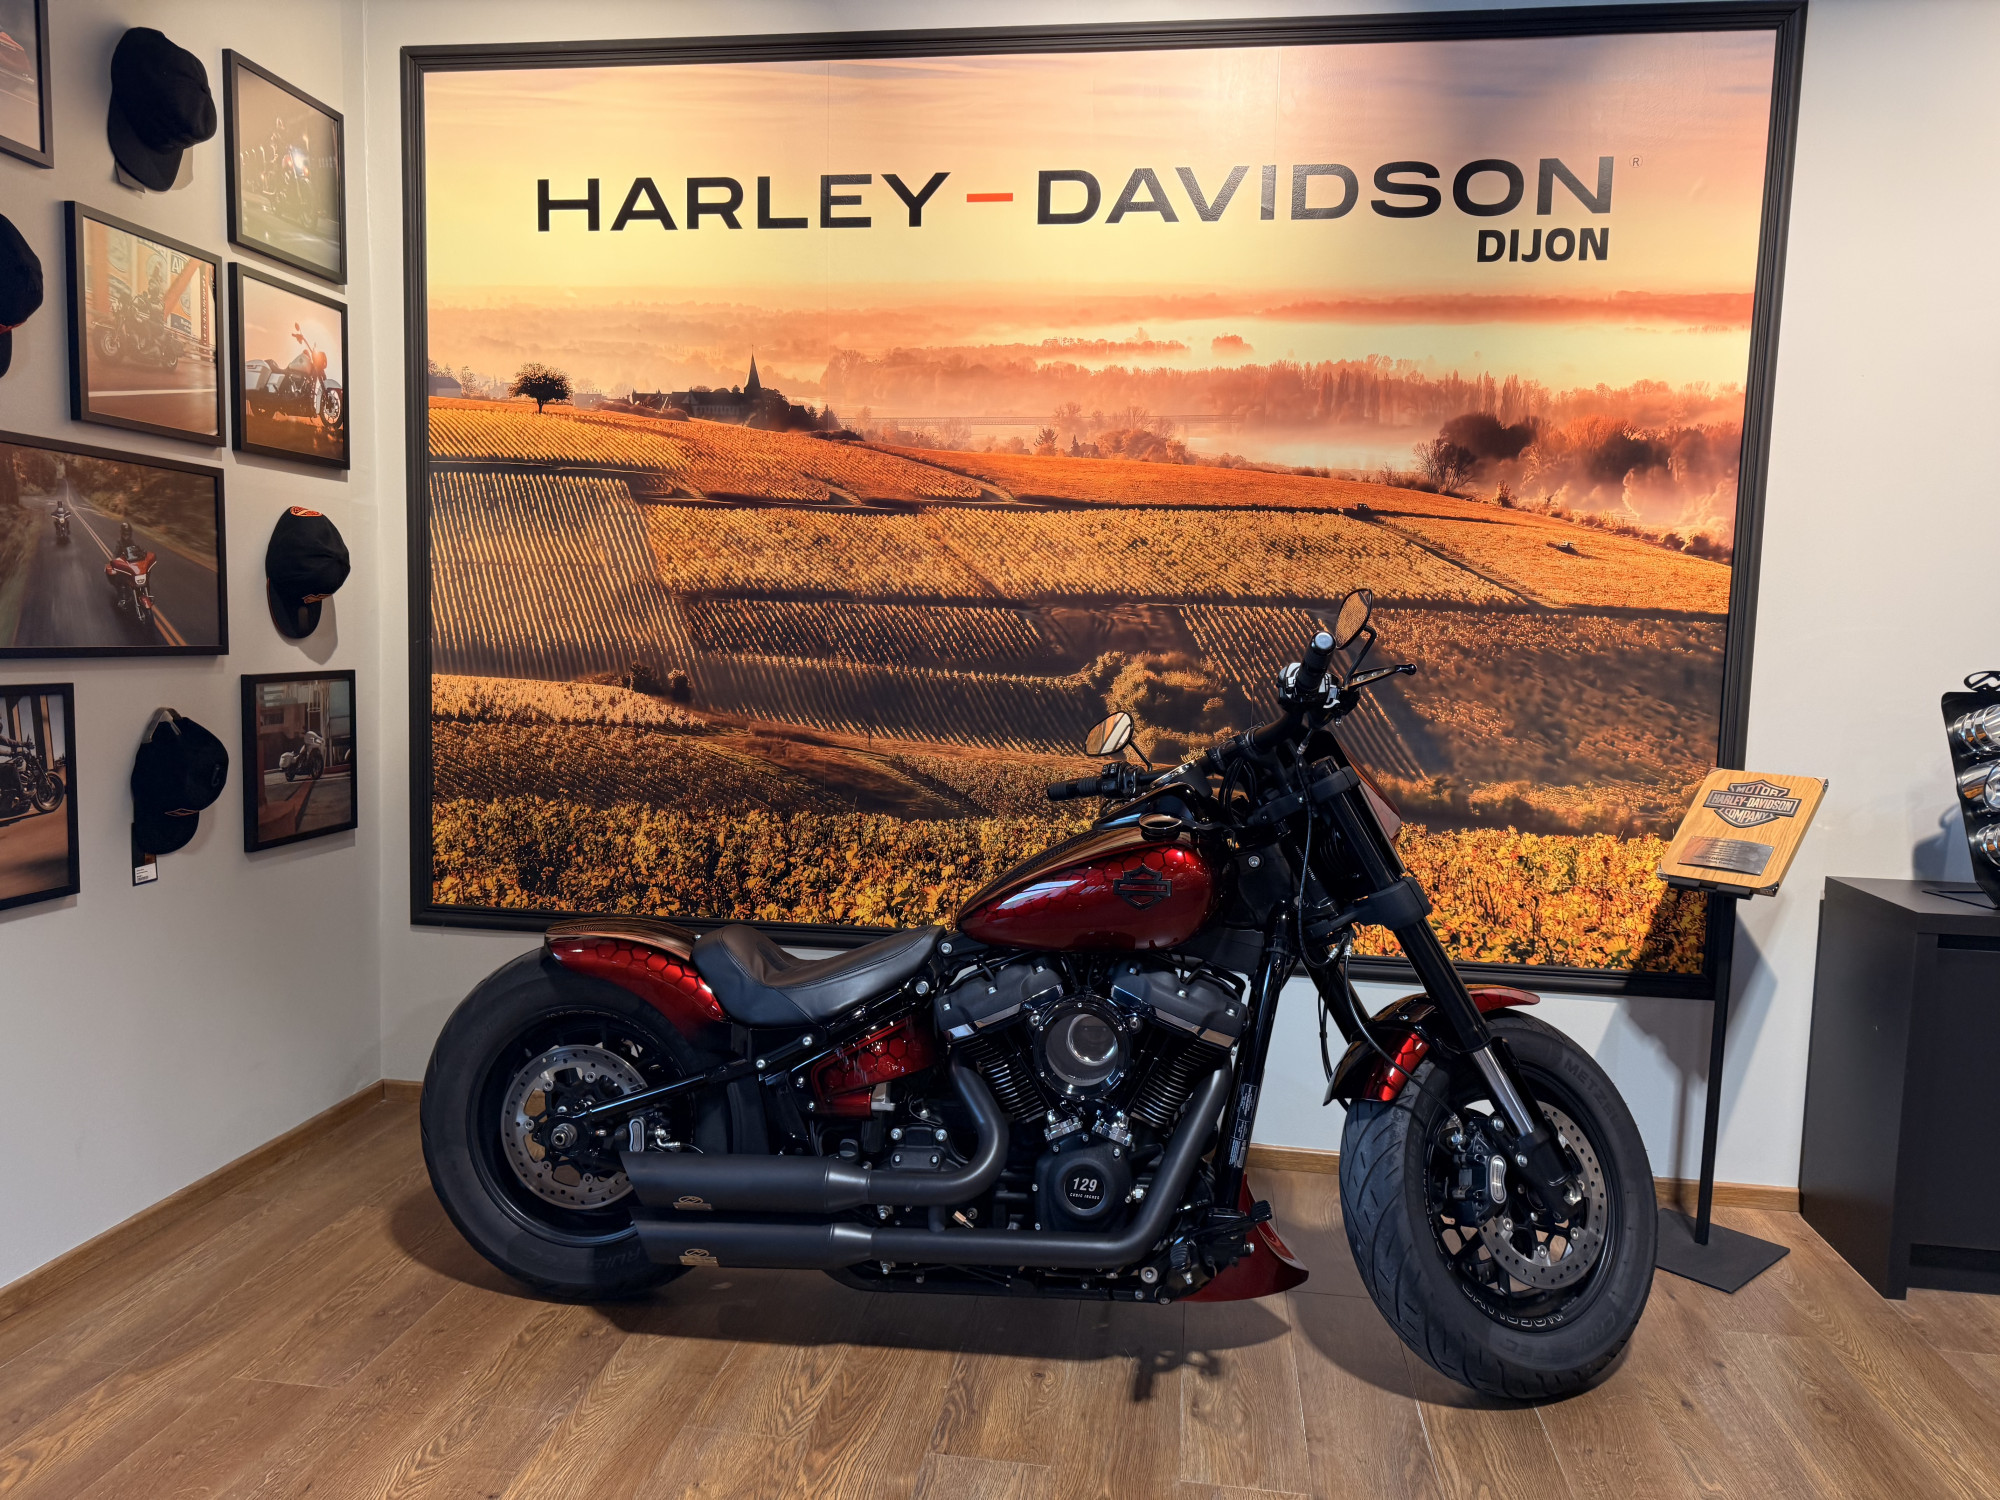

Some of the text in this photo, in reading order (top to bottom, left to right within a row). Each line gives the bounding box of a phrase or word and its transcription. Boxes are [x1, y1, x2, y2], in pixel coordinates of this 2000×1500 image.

[1476, 227, 1610, 263] DIJON
[1736, 782, 1779, 797] MOTOR
[1711, 793, 1794, 812] HARLEY-DAVIDSON
[1724, 808, 1769, 823] COMPANY
[1073, 1177, 1098, 1192] 129
